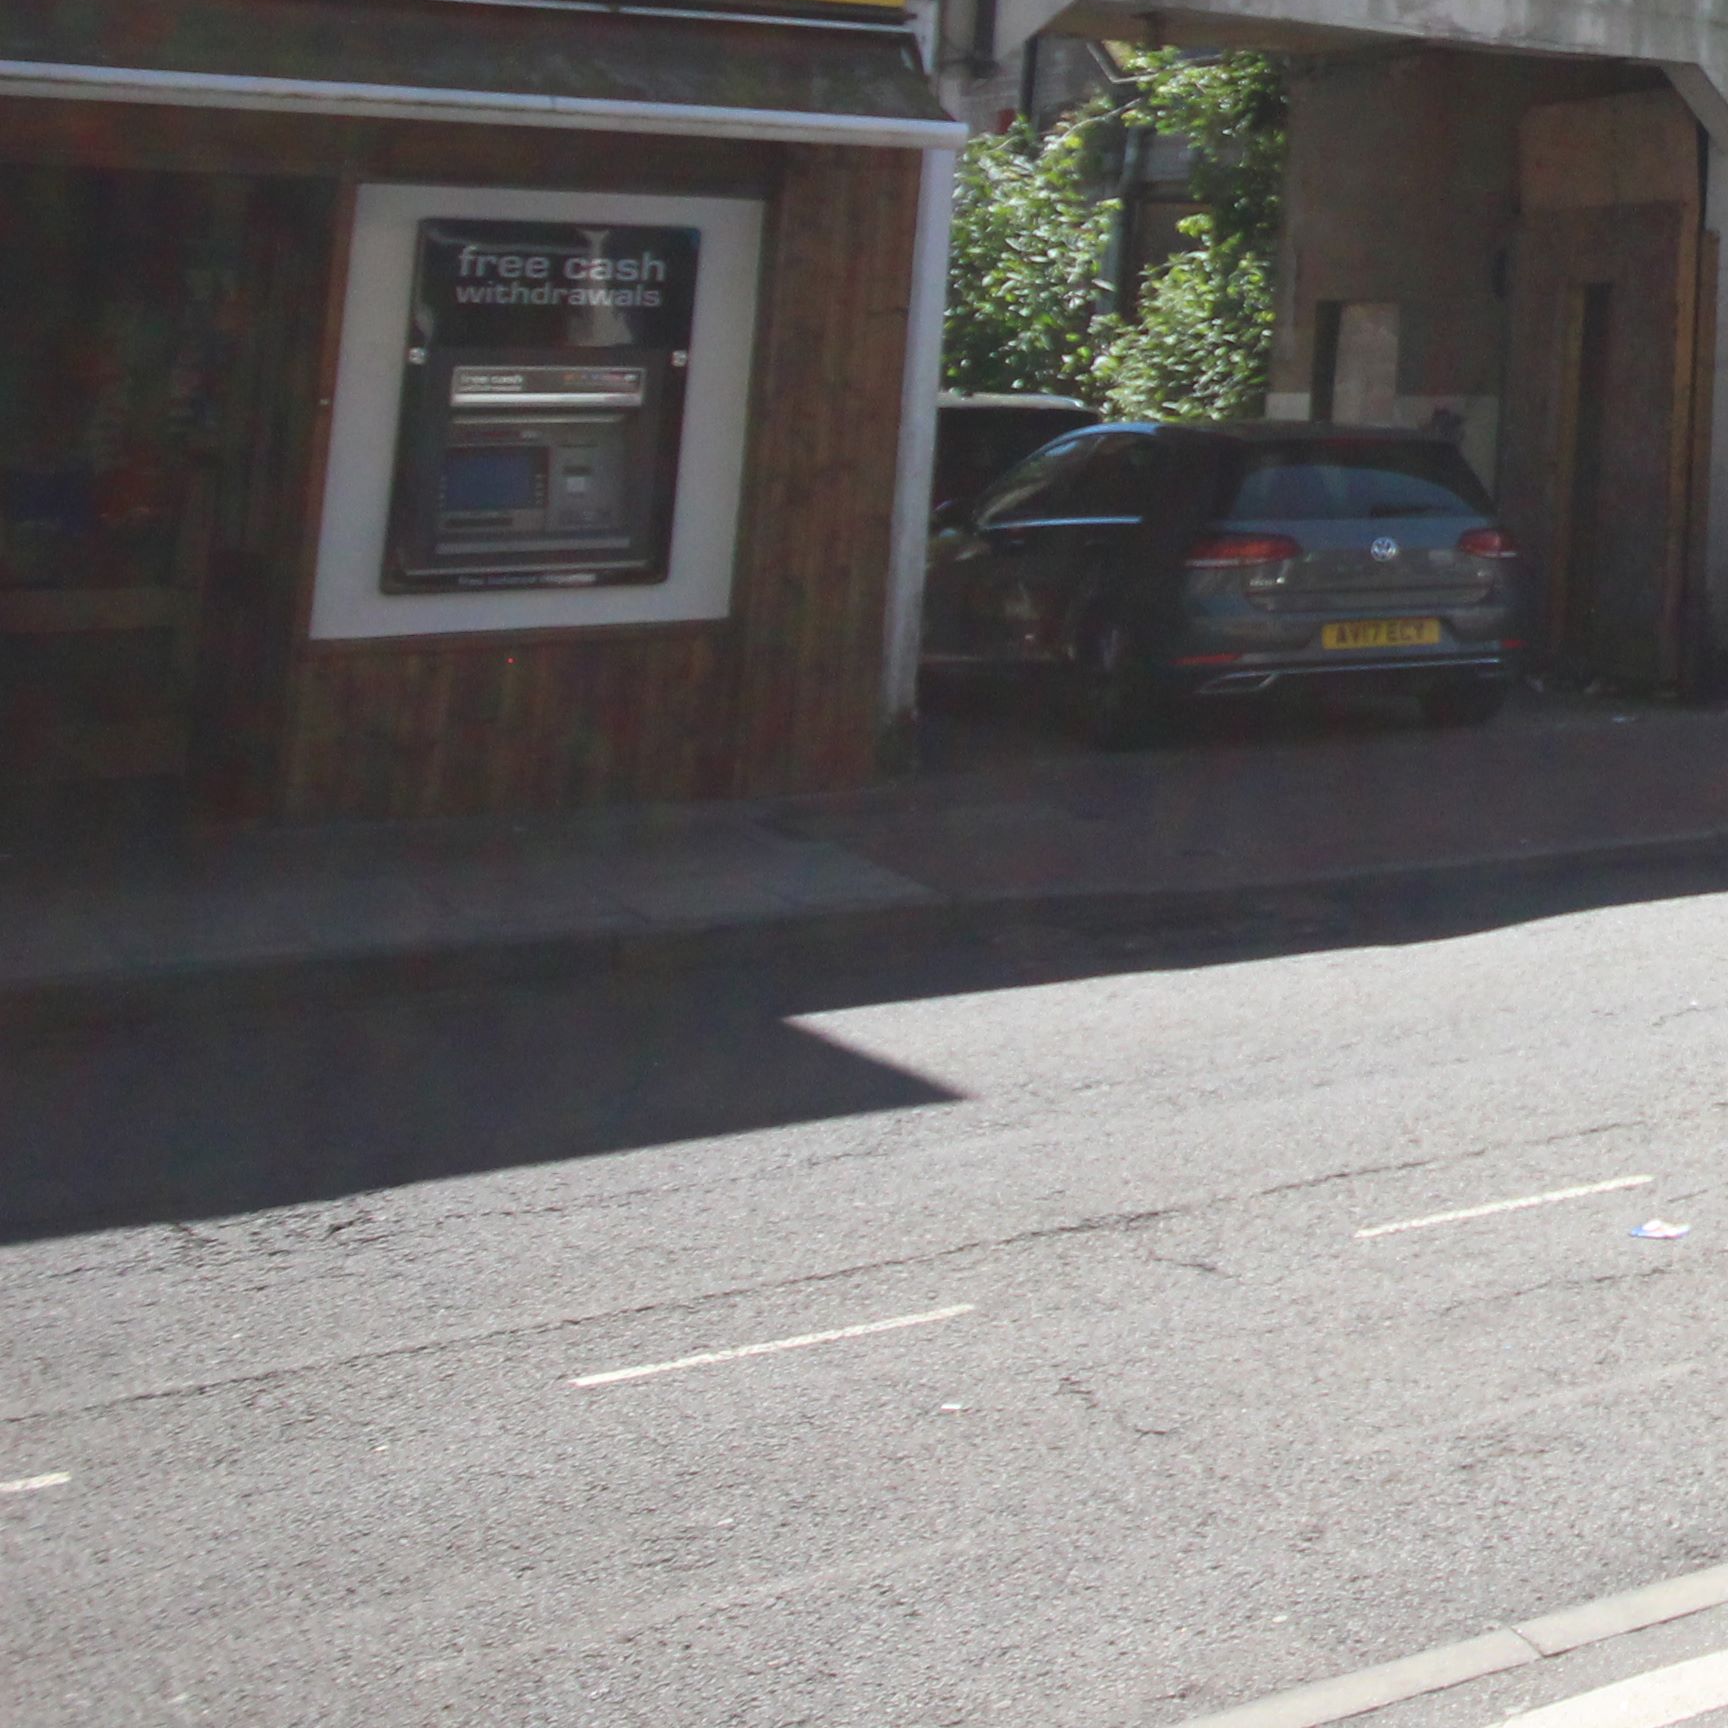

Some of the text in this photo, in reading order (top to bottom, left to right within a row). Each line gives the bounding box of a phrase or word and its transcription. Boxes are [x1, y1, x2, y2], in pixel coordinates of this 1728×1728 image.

[459, 245, 666, 282] free cash
[456, 281, 663, 307] withdrawals
